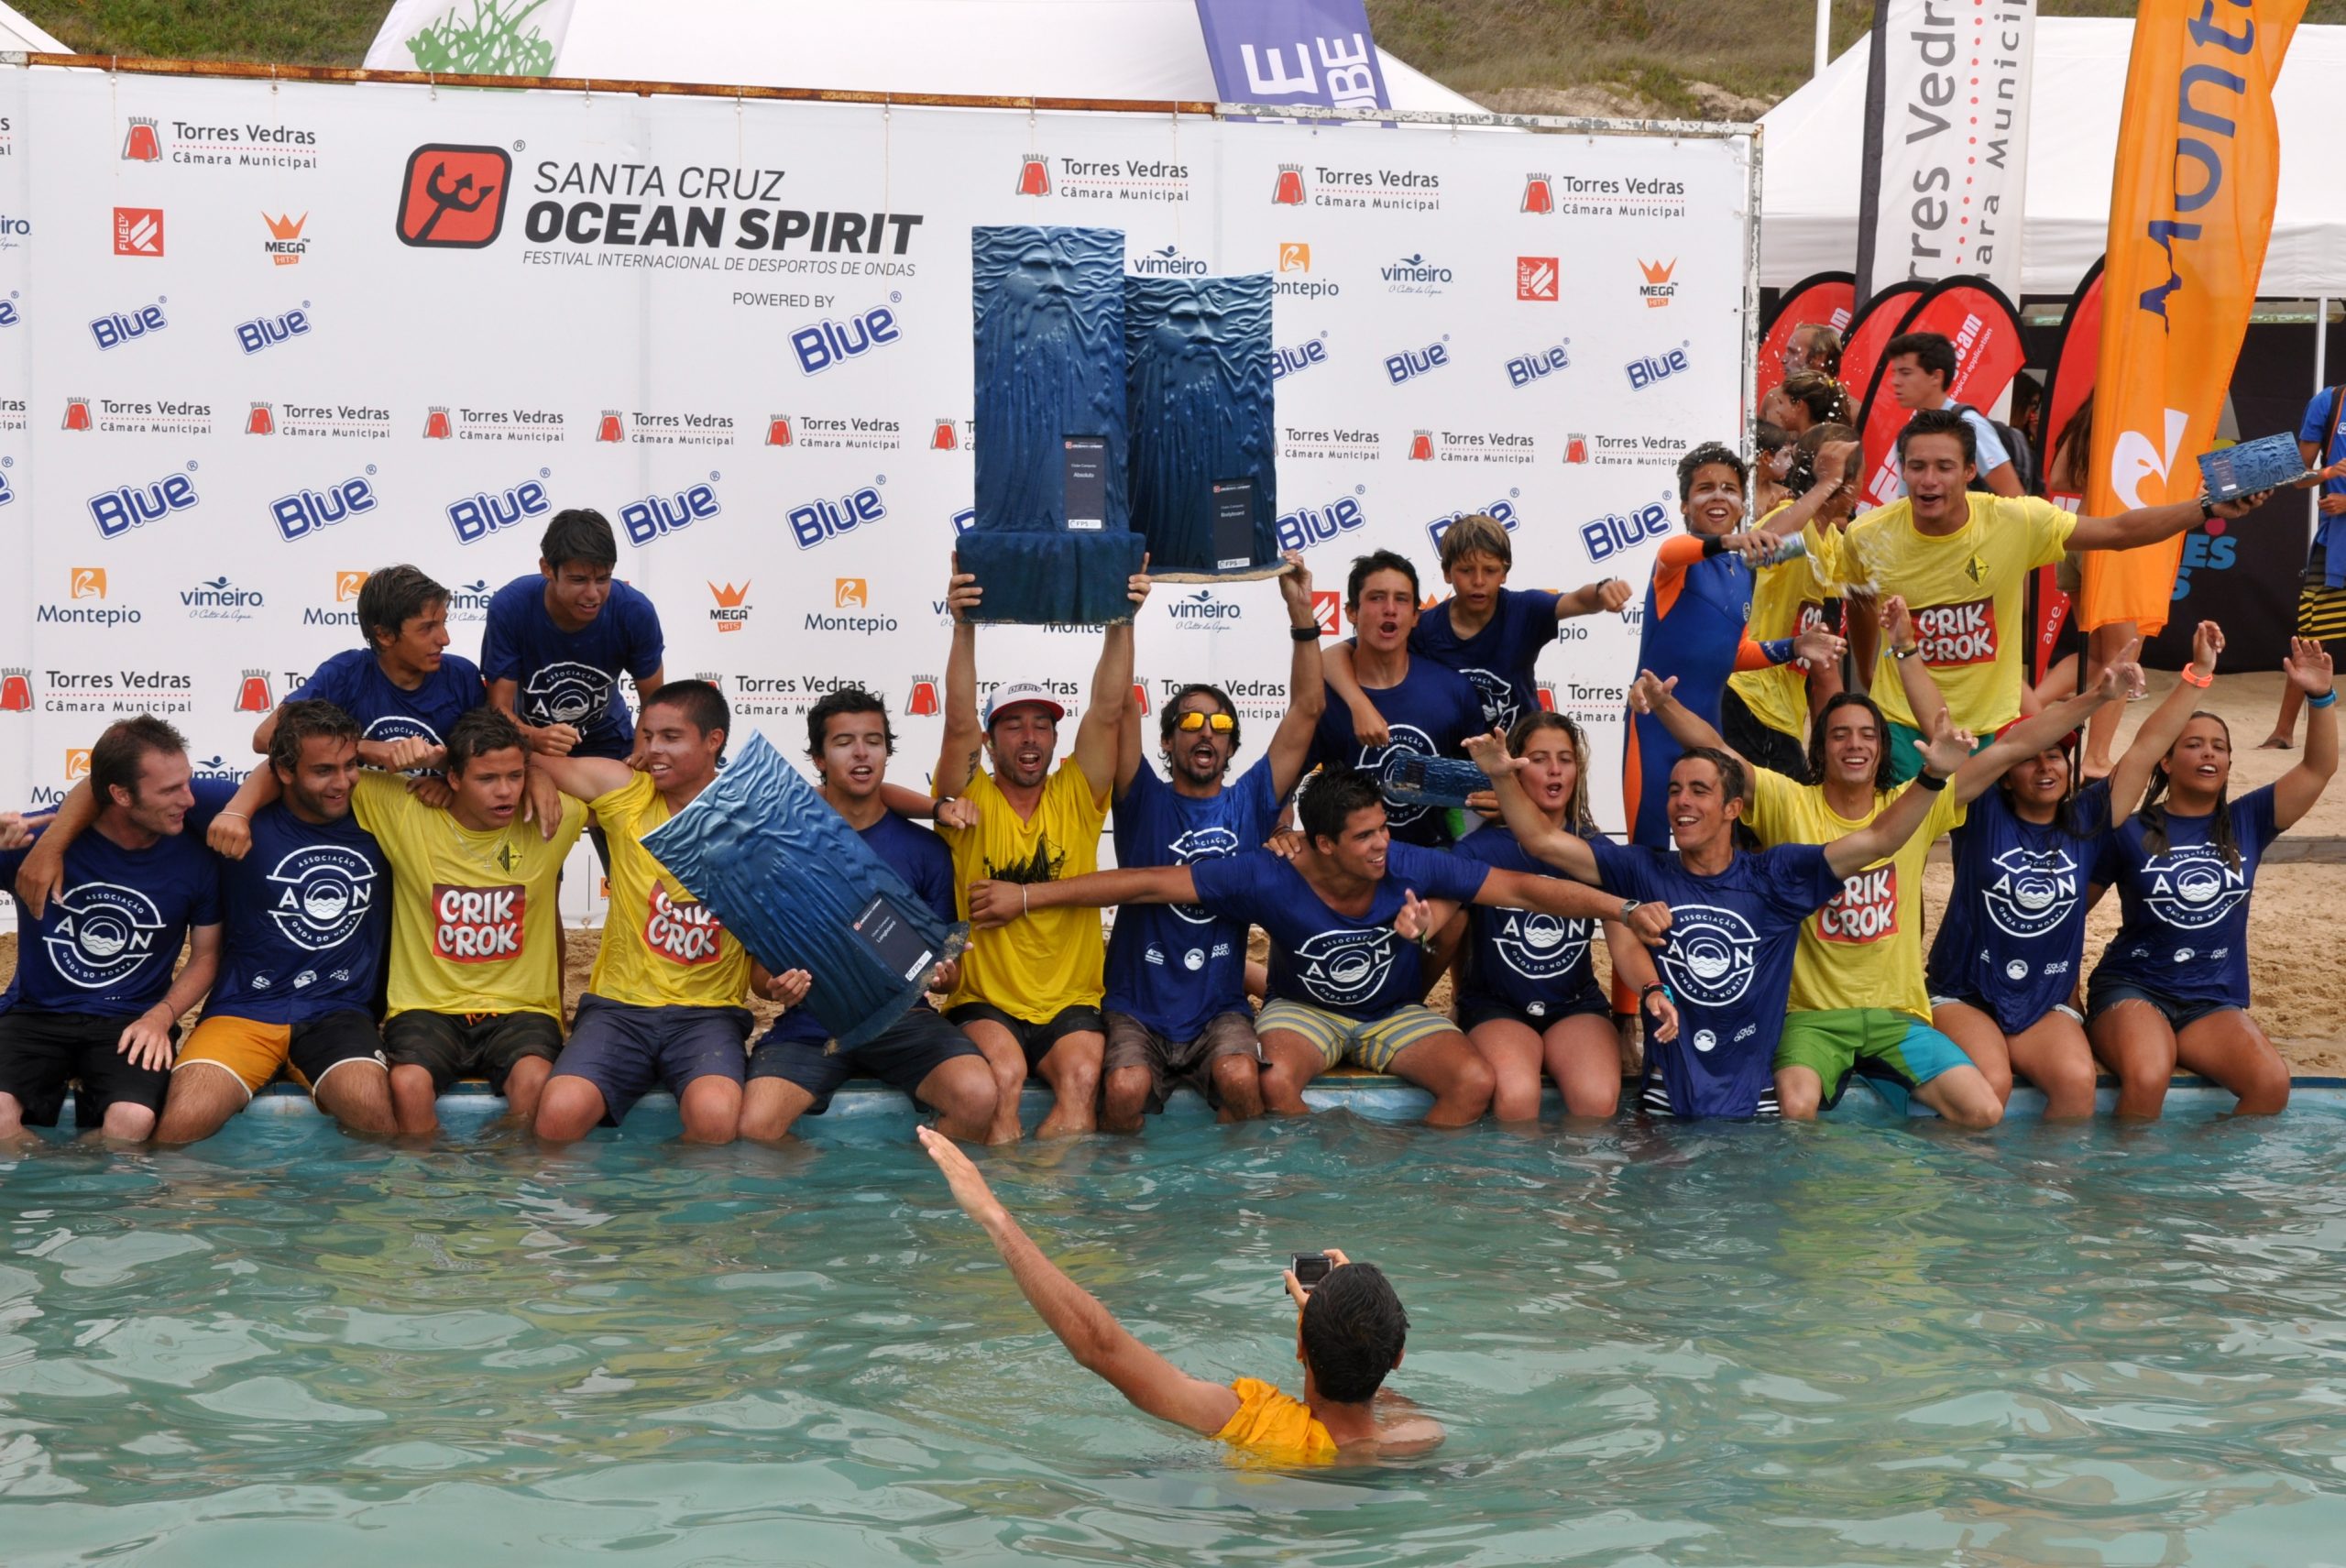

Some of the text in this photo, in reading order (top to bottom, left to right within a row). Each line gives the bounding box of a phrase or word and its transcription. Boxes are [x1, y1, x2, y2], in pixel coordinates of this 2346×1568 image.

[172, 122, 315, 145] Torres Vedras
[173, 152, 315, 170] Câmara Municipal
[1061, 159, 1188, 178] Torres Vedras
[533, 161, 785, 202] SANTA CRUZ
[1316, 168, 1439, 187] Torres Vedras
[1563, 176, 1683, 194] Torres Vedras
[1061, 187, 1188, 203] Câmara Municipal
[1316, 195, 1439, 212] Câmara Municipal
[1563, 204, 1683, 218] Câmara Municipal
[524, 201, 924, 255] OCEAN SPIRIT
[265, 242, 306, 254] MEGA
[276, 256, 298, 264] HITS
[522, 251, 915, 277] FESTIVAL INTERNACIONAL DE DESPORTOS DE ONDAS
[1134, 256, 1207, 275] vimeiro
[1381, 264, 1452, 282] vimeiro
[733, 292, 835, 308] POWERED BY
[1640, 286, 1674, 297] MEGA
[90, 305, 167, 350] Blue
[236, 311, 310, 354] Blue
[790, 306, 901, 374] Blue
[1384, 343, 1449, 385] Blue
[1506, 346, 1569, 387] Blue
[1626, 348, 1688, 389] Blue
[101, 400, 210, 415] Torres Vedras
[283, 404, 389, 420] Torres Vedras
[460, 409, 563, 423] Torres Vedras
[101, 422, 210, 434] Câmara Municipal
[632, 412, 733, 427] Torres Vedras
[801, 417, 899, 432] Torres Vedras
[283, 427, 389, 439] Câmara Municipal
[460, 431, 563, 442] Câmara Municipal
[632, 434, 733, 445] Câmara Municipal
[1286, 429, 1379, 443] Torres Vedras
[1442, 433, 1533, 446] Torres Vedras
[1595, 435, 1686, 449] Torres Vedras
[801, 439, 899, 450] Câmara Municipal
[1286, 449, 1378, 460] Câmara Municipal
[1485, 455, 1533, 464] Municipal
[1595, 456, 1632, 466] Câmara
[89, 475, 198, 538] Blue
[271, 478, 376, 541] Blue
[448, 481, 550, 543] Blue
[620, 484, 719, 546] Blue
[787, 488, 885, 549] Blue
[1276, 498, 1365, 552] Blue
[1581, 503, 1671, 562] Blue
[180, 588, 264, 607] vimeiro
[37, 605, 141, 627] Montepio
[709, 609, 748, 620] MEGA
[1168, 598, 1241, 618] vimeiro
[805, 613, 898, 635] Montepio
[1919, 603, 1987, 639] CRIK
[1917, 627, 1994, 663] CROK
[46, 671, 191, 688] Torres Vedras
[736, 675, 867, 694] Torres Vedras
[1223, 680, 1285, 698] Vedras
[1568, 684, 1623, 700] Torres
[46, 700, 191, 716] Câmara Municipal
[735, 704, 788, 715] Câmara
[1567, 711, 1617, 723] Câmara
[440, 890, 515, 925] CRIK
[1822, 900, 1895, 938] CROK
[438, 922, 519, 958] CROK
[648, 915, 716, 959] CROK
